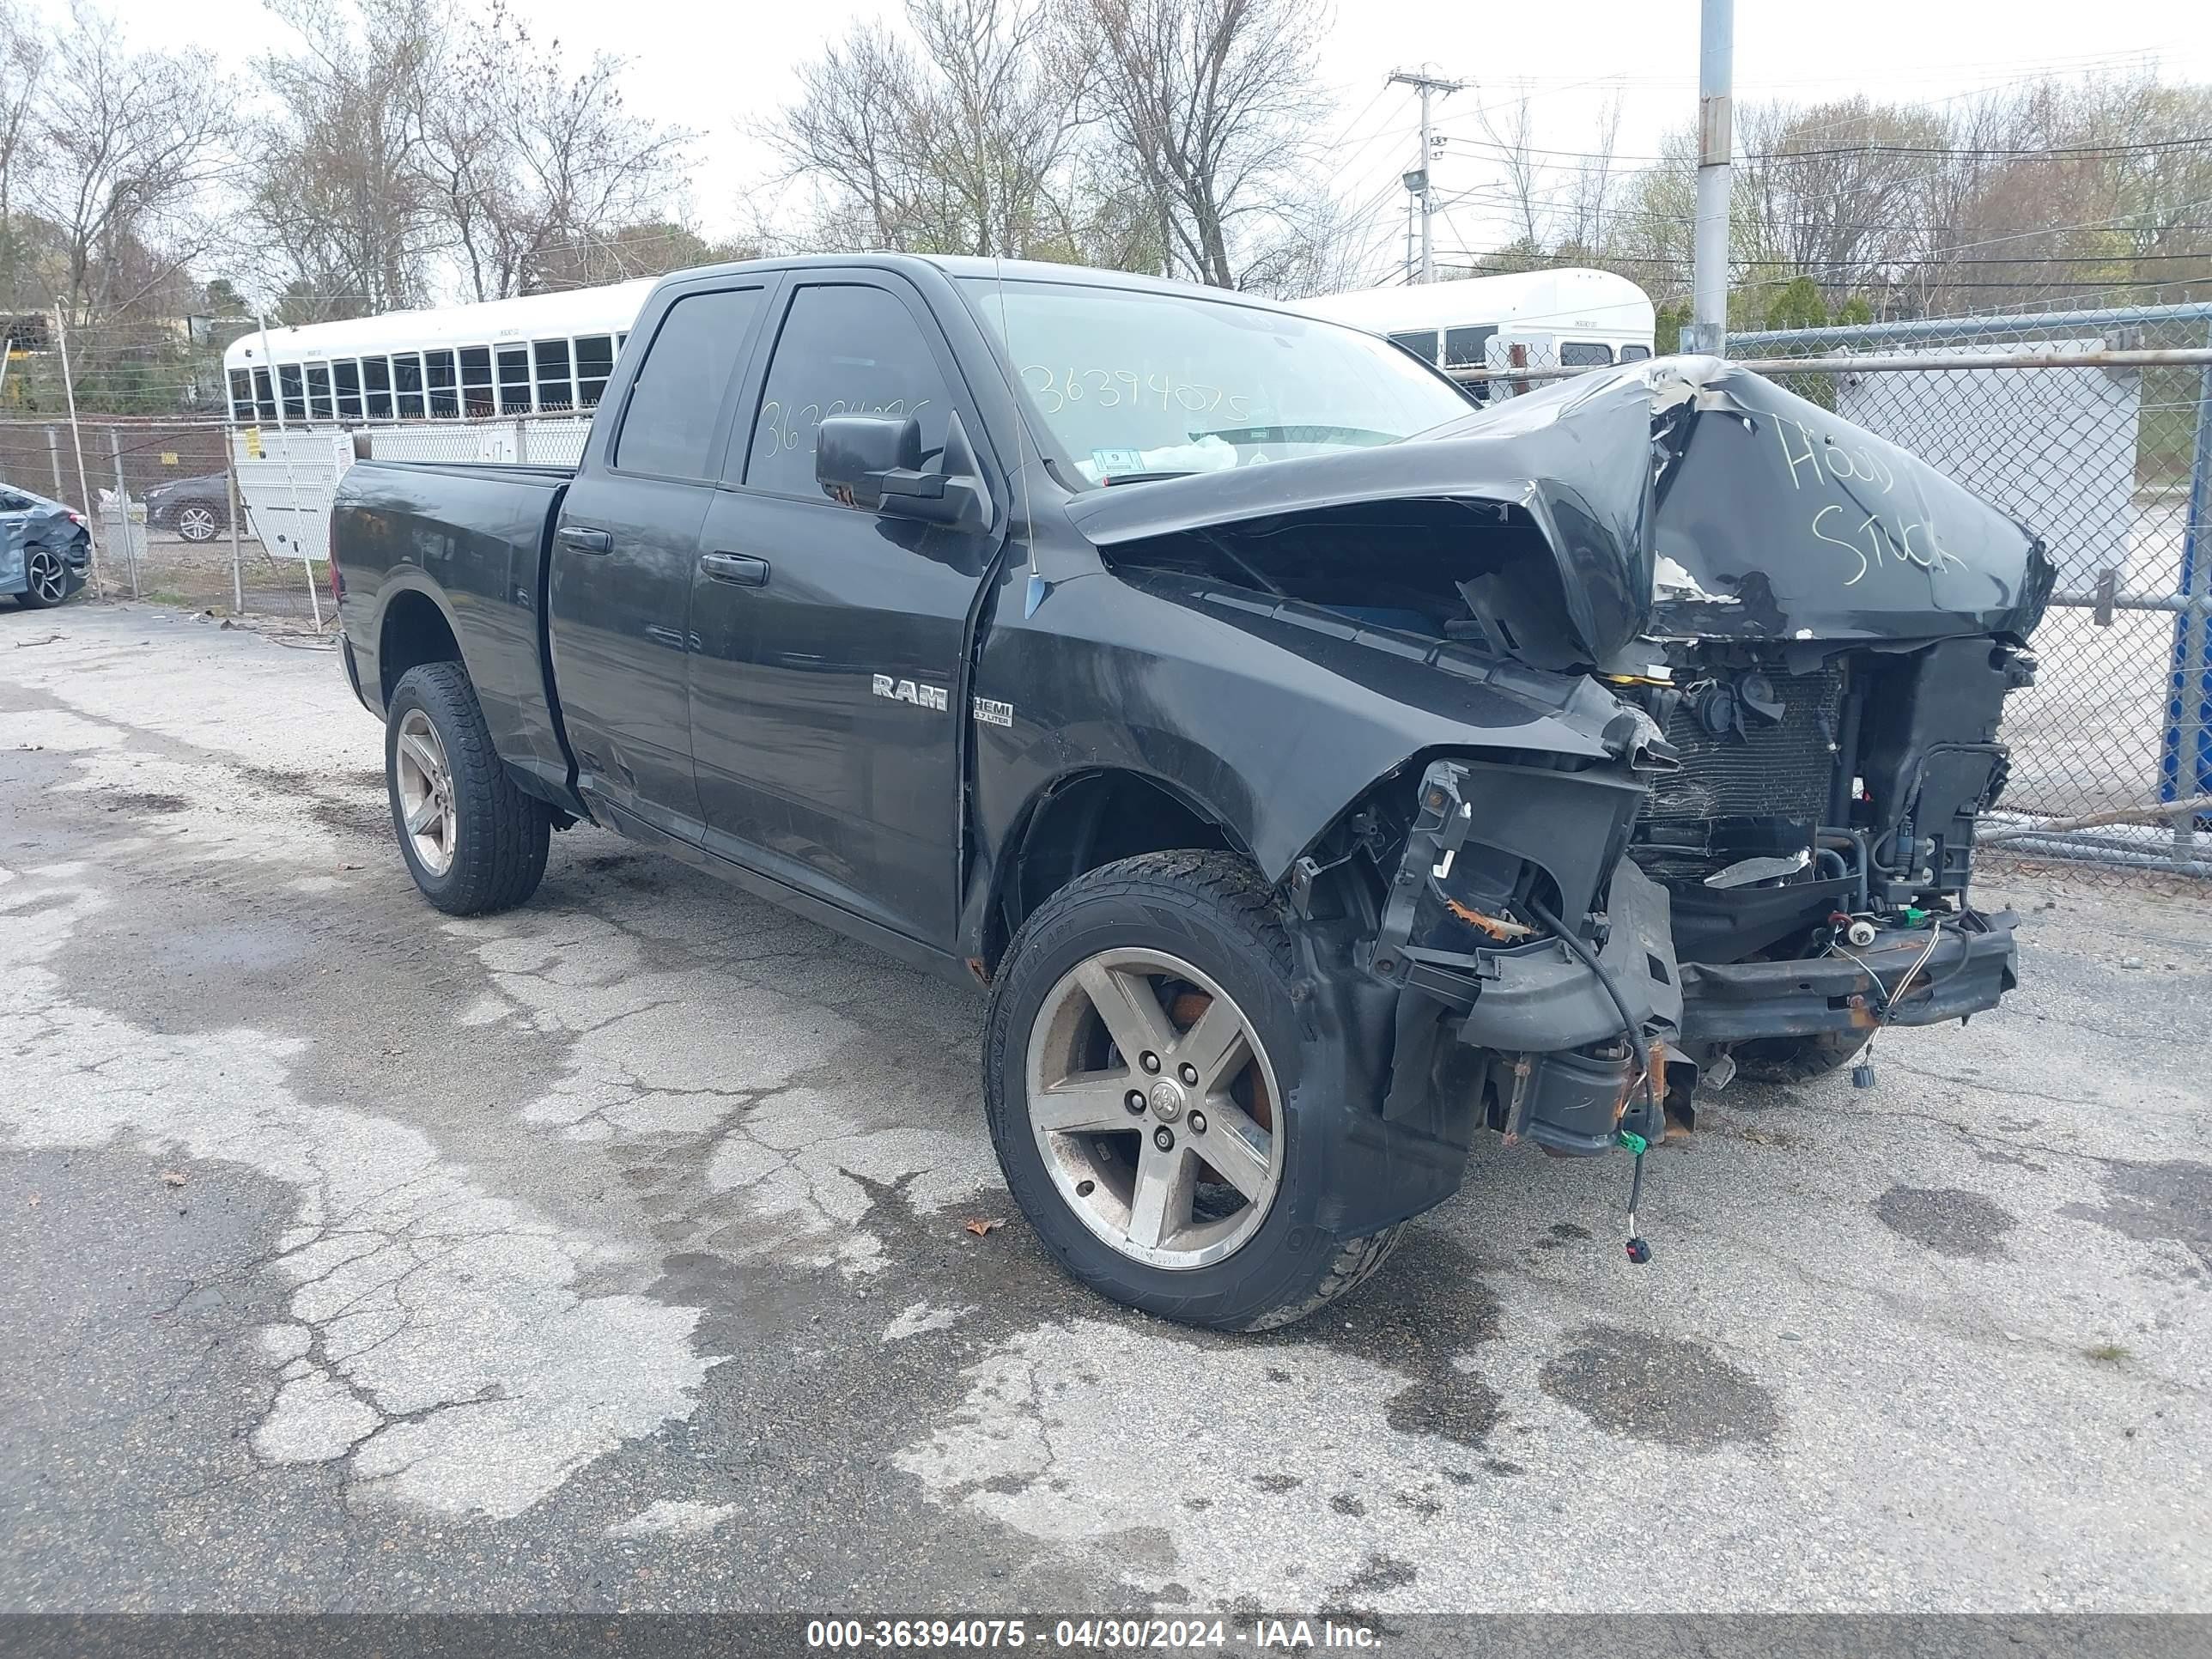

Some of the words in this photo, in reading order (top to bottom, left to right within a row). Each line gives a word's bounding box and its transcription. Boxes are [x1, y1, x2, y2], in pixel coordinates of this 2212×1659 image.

[1020, 365, 1249, 422] 36394075
[872, 673, 949, 713] RAM
[974, 697, 1011, 716] HEMI
[975, 711, 987, 720] 5.7
[988, 714, 1009, 726] LITER
